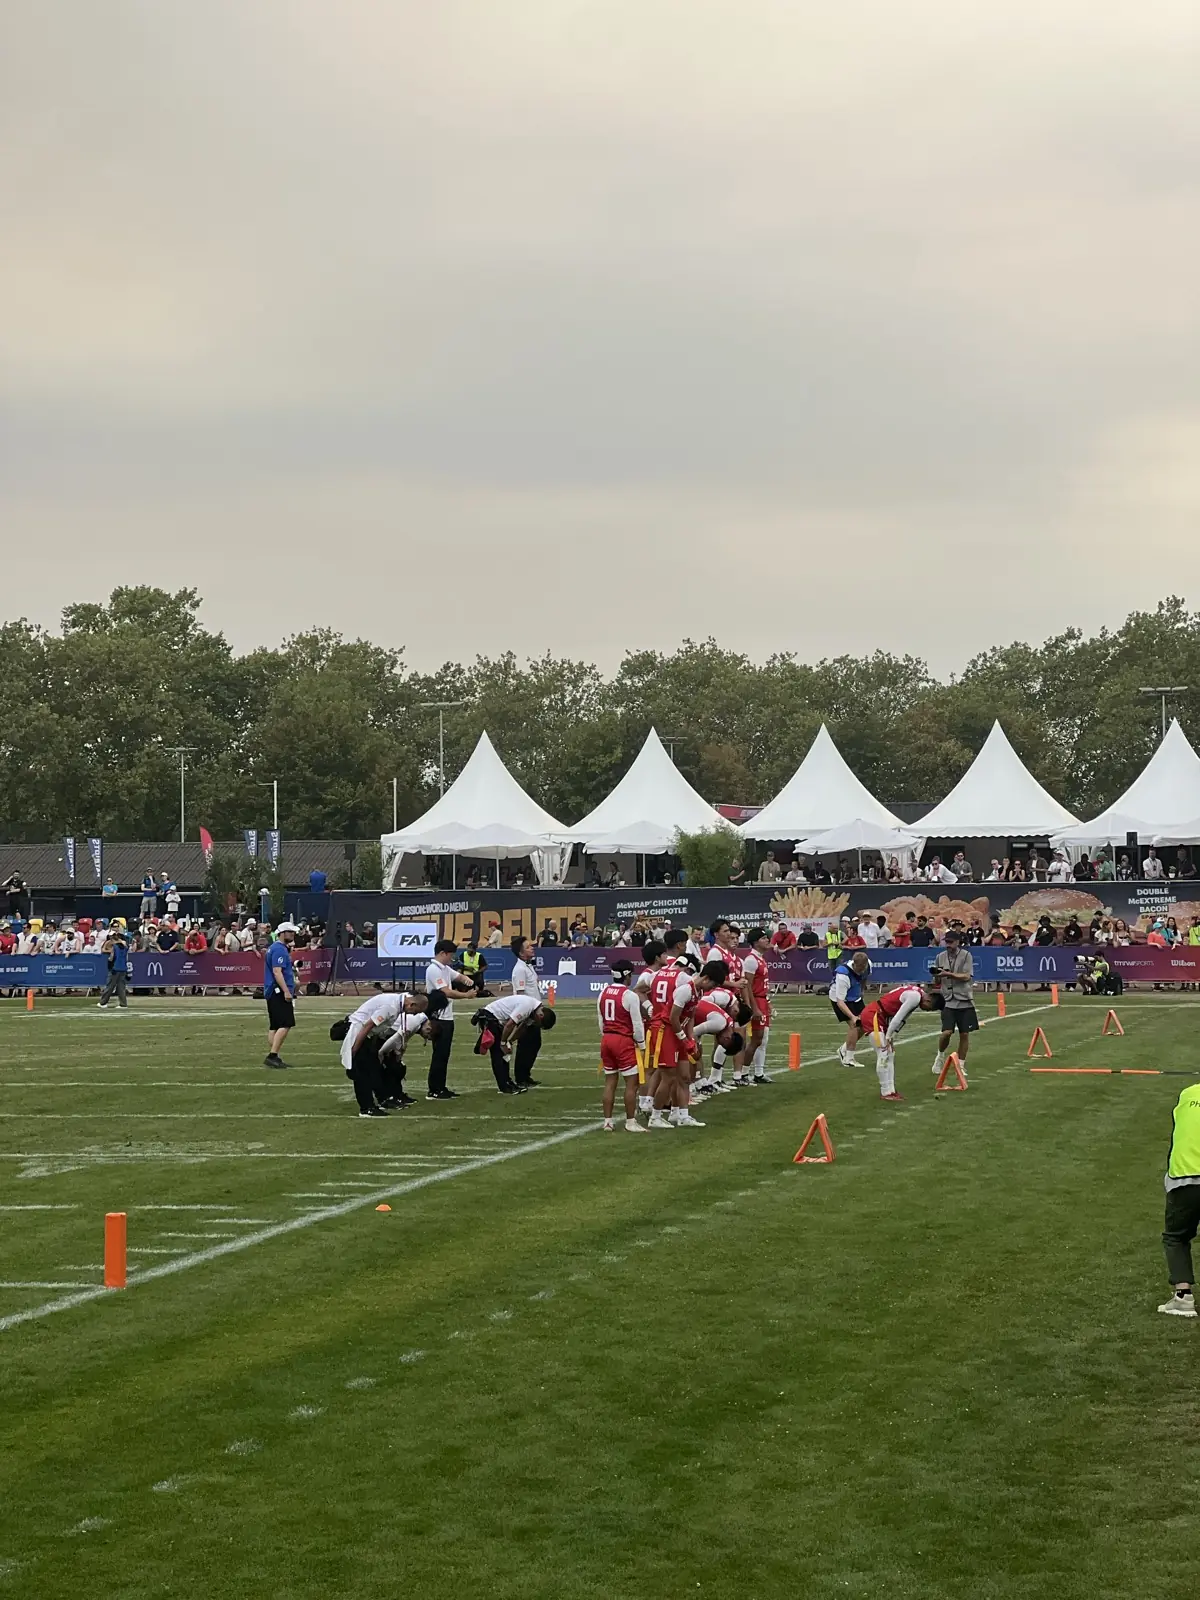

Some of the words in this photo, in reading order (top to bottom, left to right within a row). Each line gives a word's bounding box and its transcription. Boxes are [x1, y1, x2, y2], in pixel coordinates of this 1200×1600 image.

[653, 899, 688, 907] CHICKEN
[1128, 896, 1177, 904] McEXTREME
[449, 901, 469, 912] MENU
[650, 907, 687, 915] CHIPOTLE
[996, 956, 1024, 967] DKB
[656, 980, 669, 1003] 9
